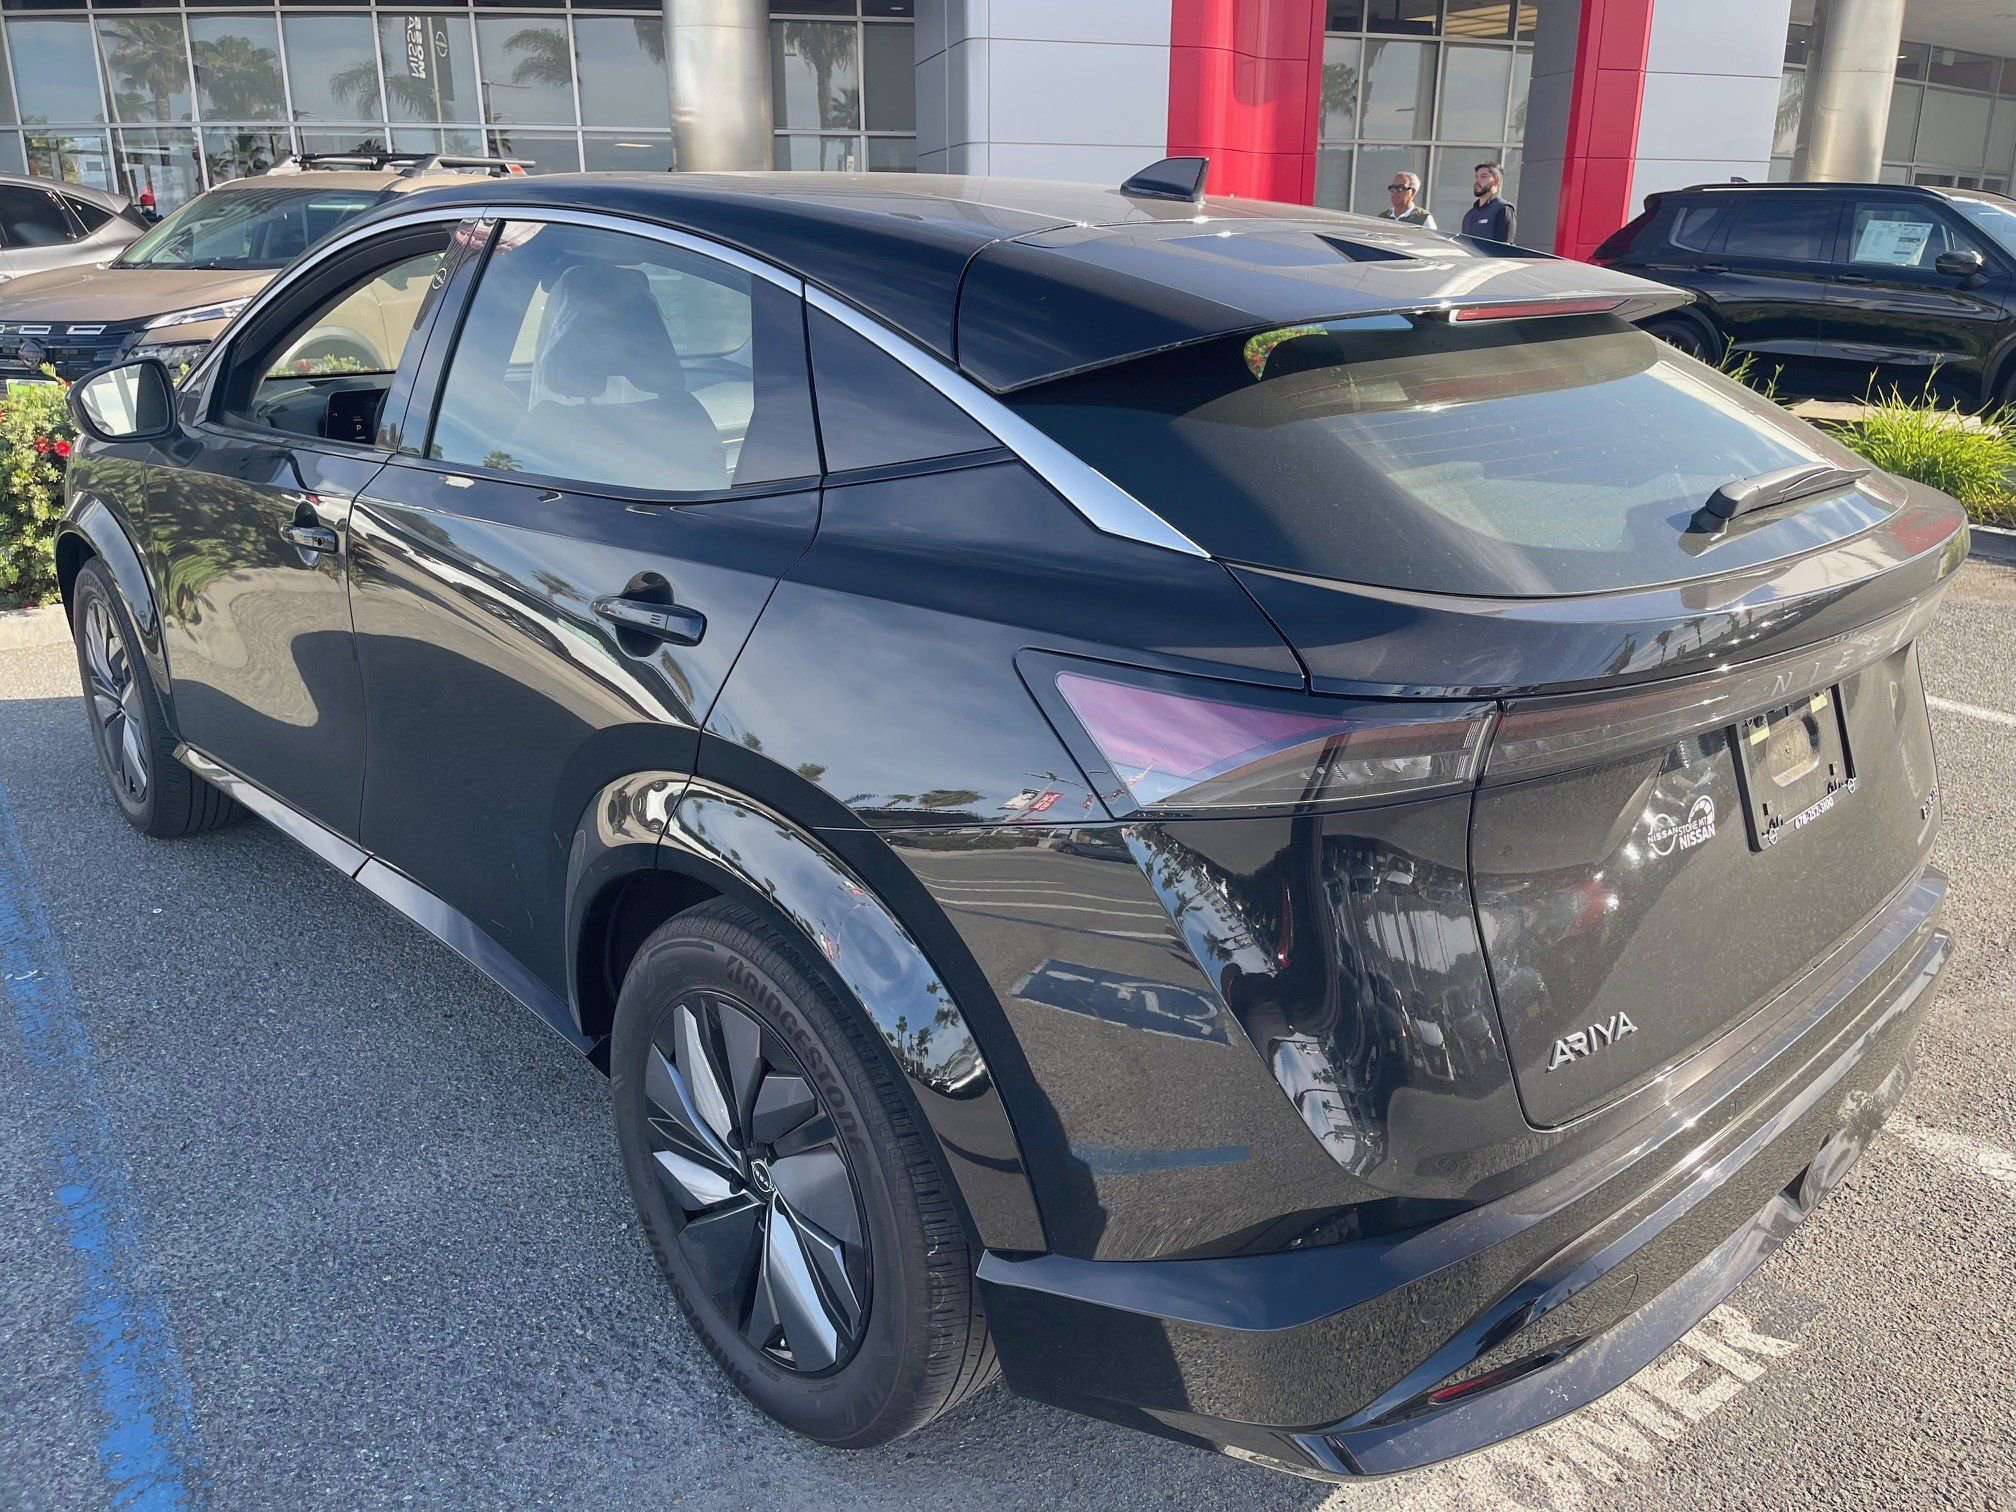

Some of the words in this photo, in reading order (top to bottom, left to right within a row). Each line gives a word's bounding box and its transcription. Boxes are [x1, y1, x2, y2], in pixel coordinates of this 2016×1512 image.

[1647, 825, 1679, 844] NISSAN
[1678, 820, 1699, 836] STONE
[1679, 822, 1716, 851] NISSAN
[726, 954, 868, 1156] BRIDGESTONE
[1546, 1011, 1639, 1072] ARIYA
